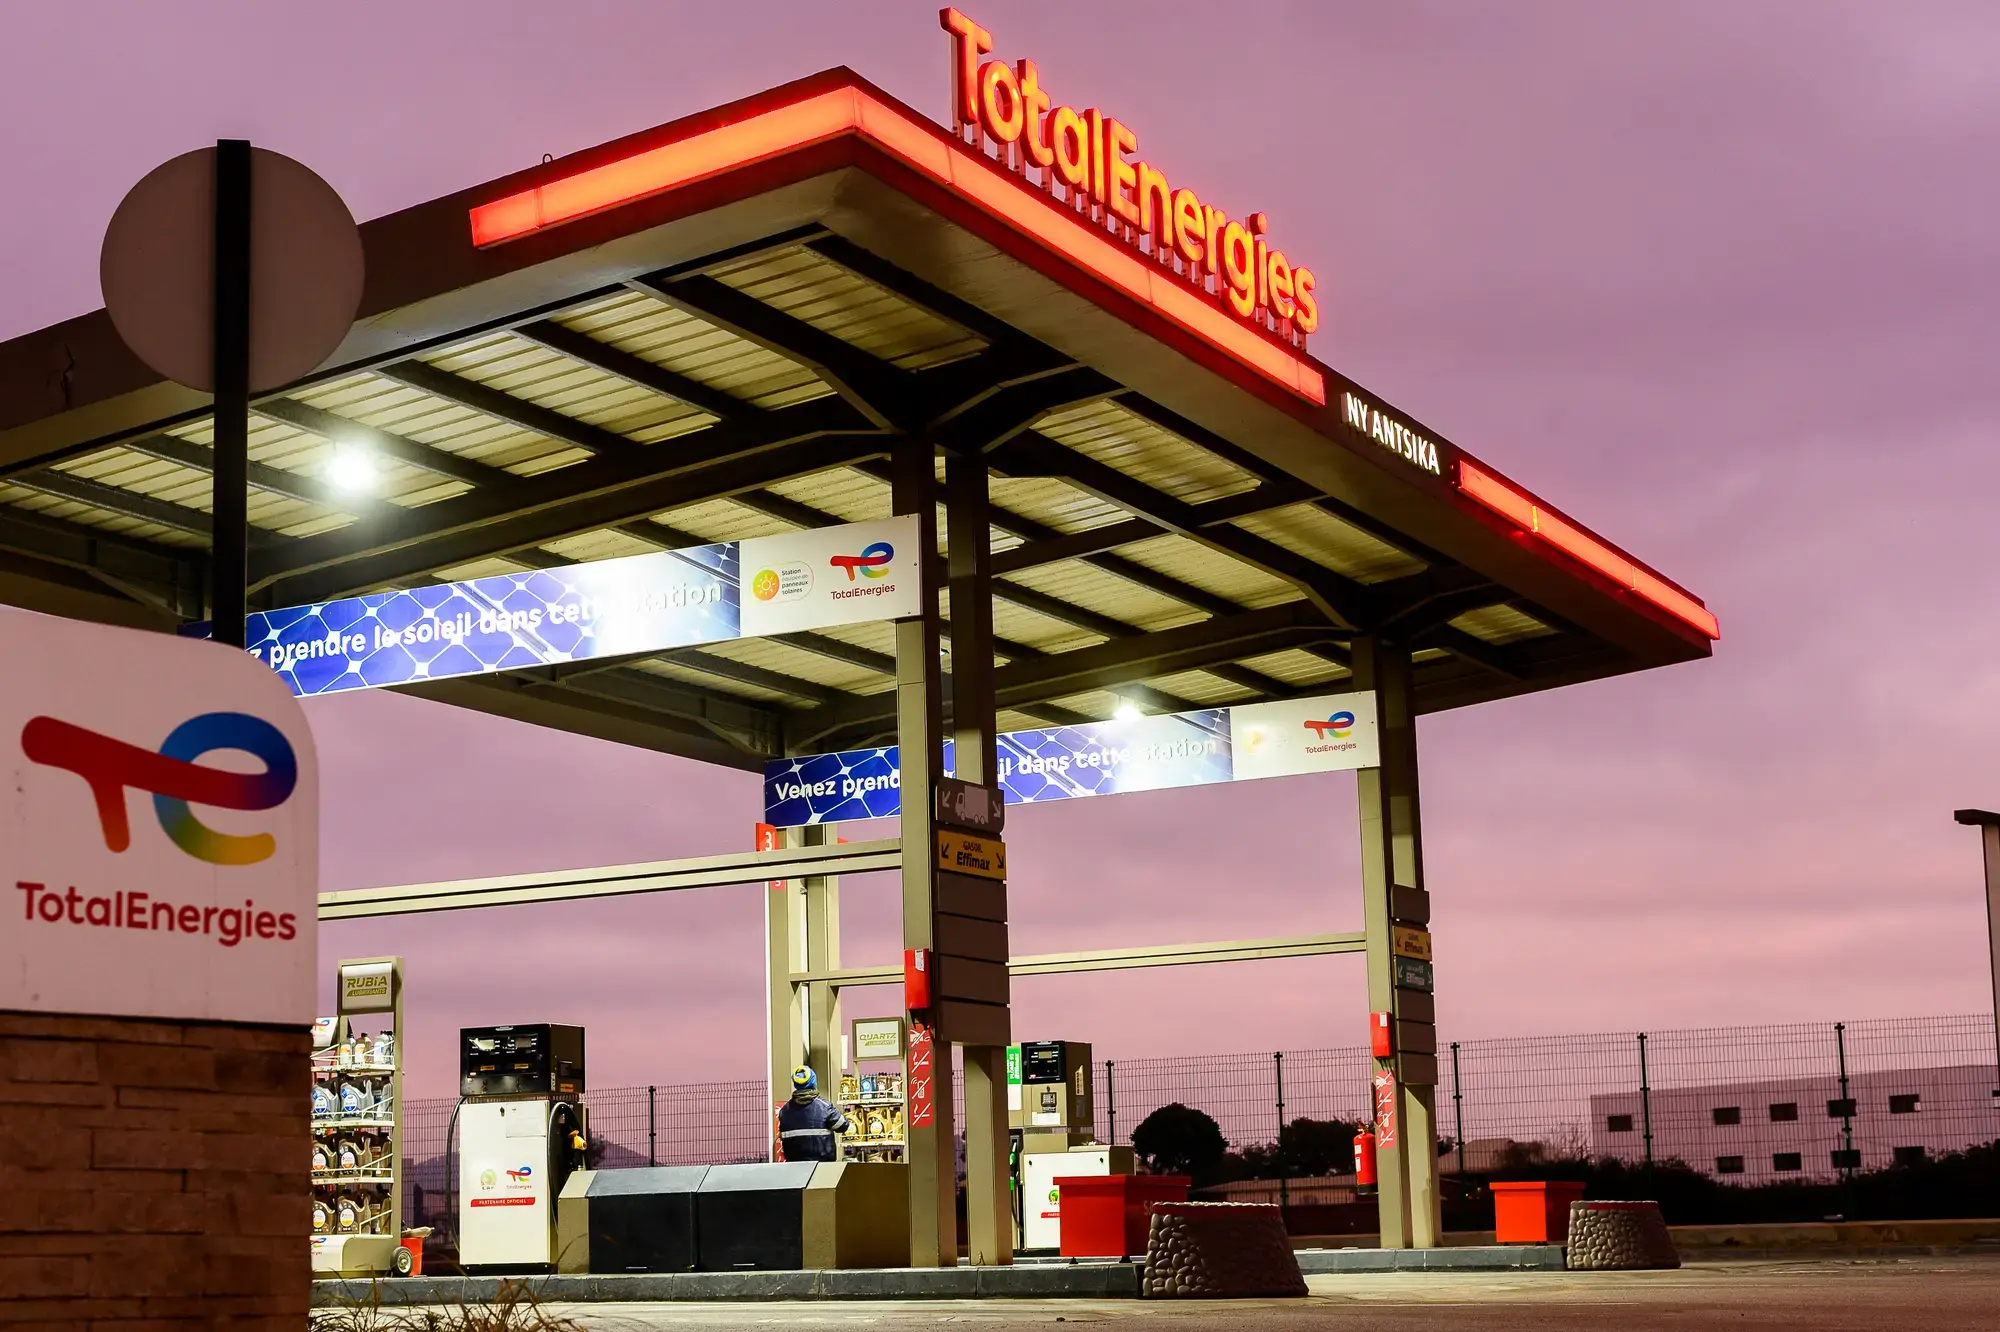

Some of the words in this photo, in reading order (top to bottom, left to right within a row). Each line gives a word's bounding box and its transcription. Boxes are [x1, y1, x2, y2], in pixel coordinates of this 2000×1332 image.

[938, 7, 1318, 334] TotalEnergies
[1345, 391, 1368, 432] NY
[1372, 410, 1441, 476] ANTSIKA
[830, 583, 896, 600] TotalEnergies
[270, 633, 366, 669] prendre
[374, 625, 395, 649] le
[403, 611, 471, 645] soleil
[480, 608, 542, 634] dans
[550, 600, 600, 624] cet
[636, 583, 722, 613] tation
[1305, 742, 1357, 754] TotalEnergies
[1018, 754, 1070, 775] dans
[775, 780, 836, 800] Venez
[842, 775, 900, 798] pren
[765, 831, 773, 851] 3
[956, 851, 990, 871] Effimax
[16, 881, 297, 947] TotalEnergies
[860, 1033, 897, 1041] QUARTZ
